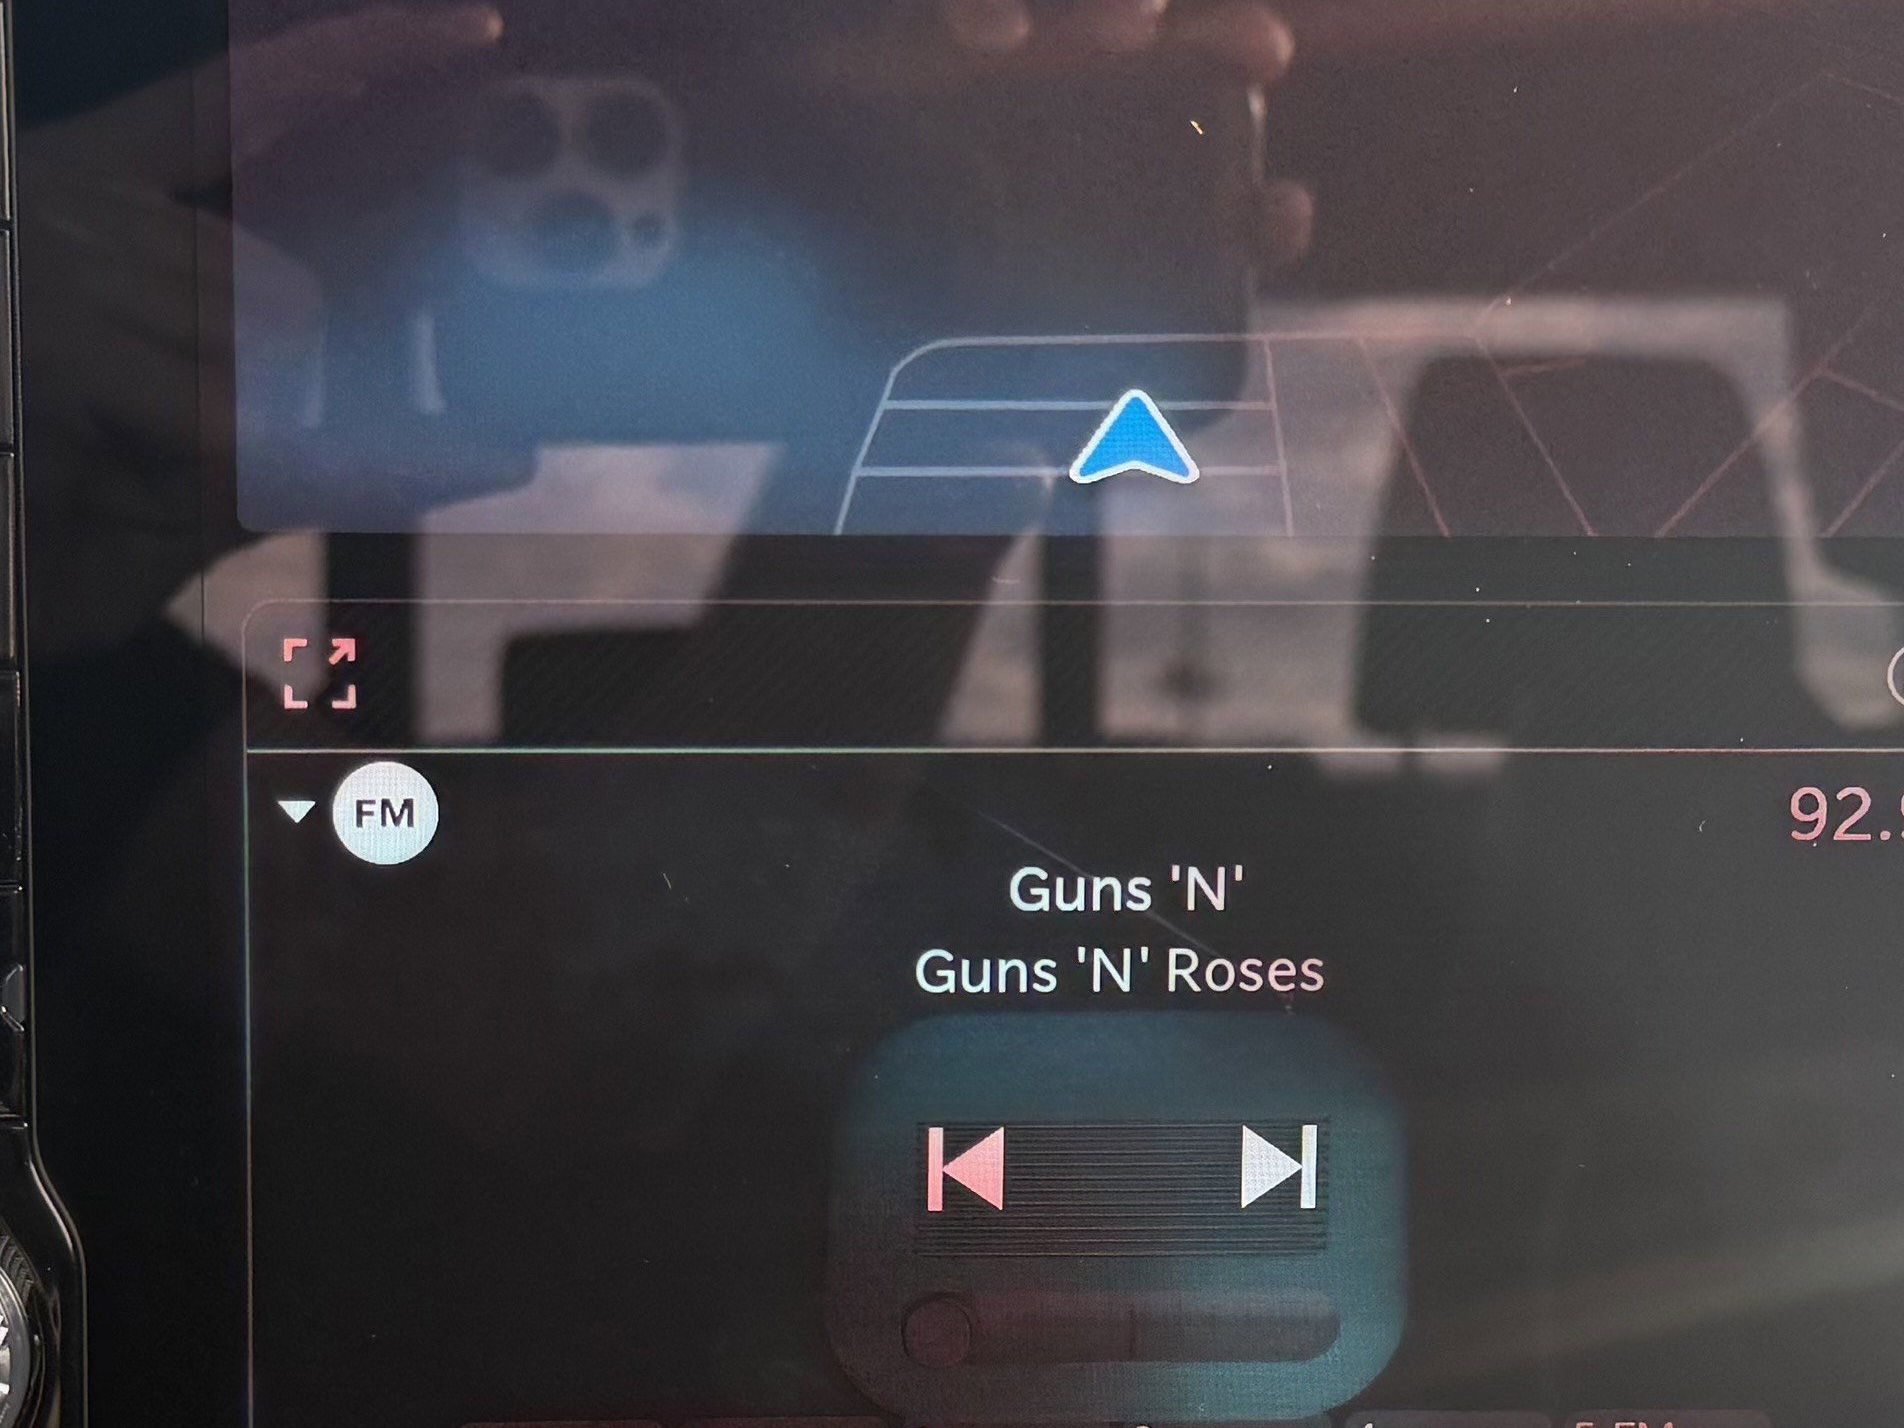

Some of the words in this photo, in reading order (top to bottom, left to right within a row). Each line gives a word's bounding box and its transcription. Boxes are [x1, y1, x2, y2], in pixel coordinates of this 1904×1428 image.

[355, 797, 415, 829] FM
[1009, 866, 1153, 912] Guns
[1171, 864, 1244, 912] 'N'
[915, 948, 1058, 993] Guns
[1077, 946, 1150, 993] 'N'
[1167, 947, 1326, 993] Roses
